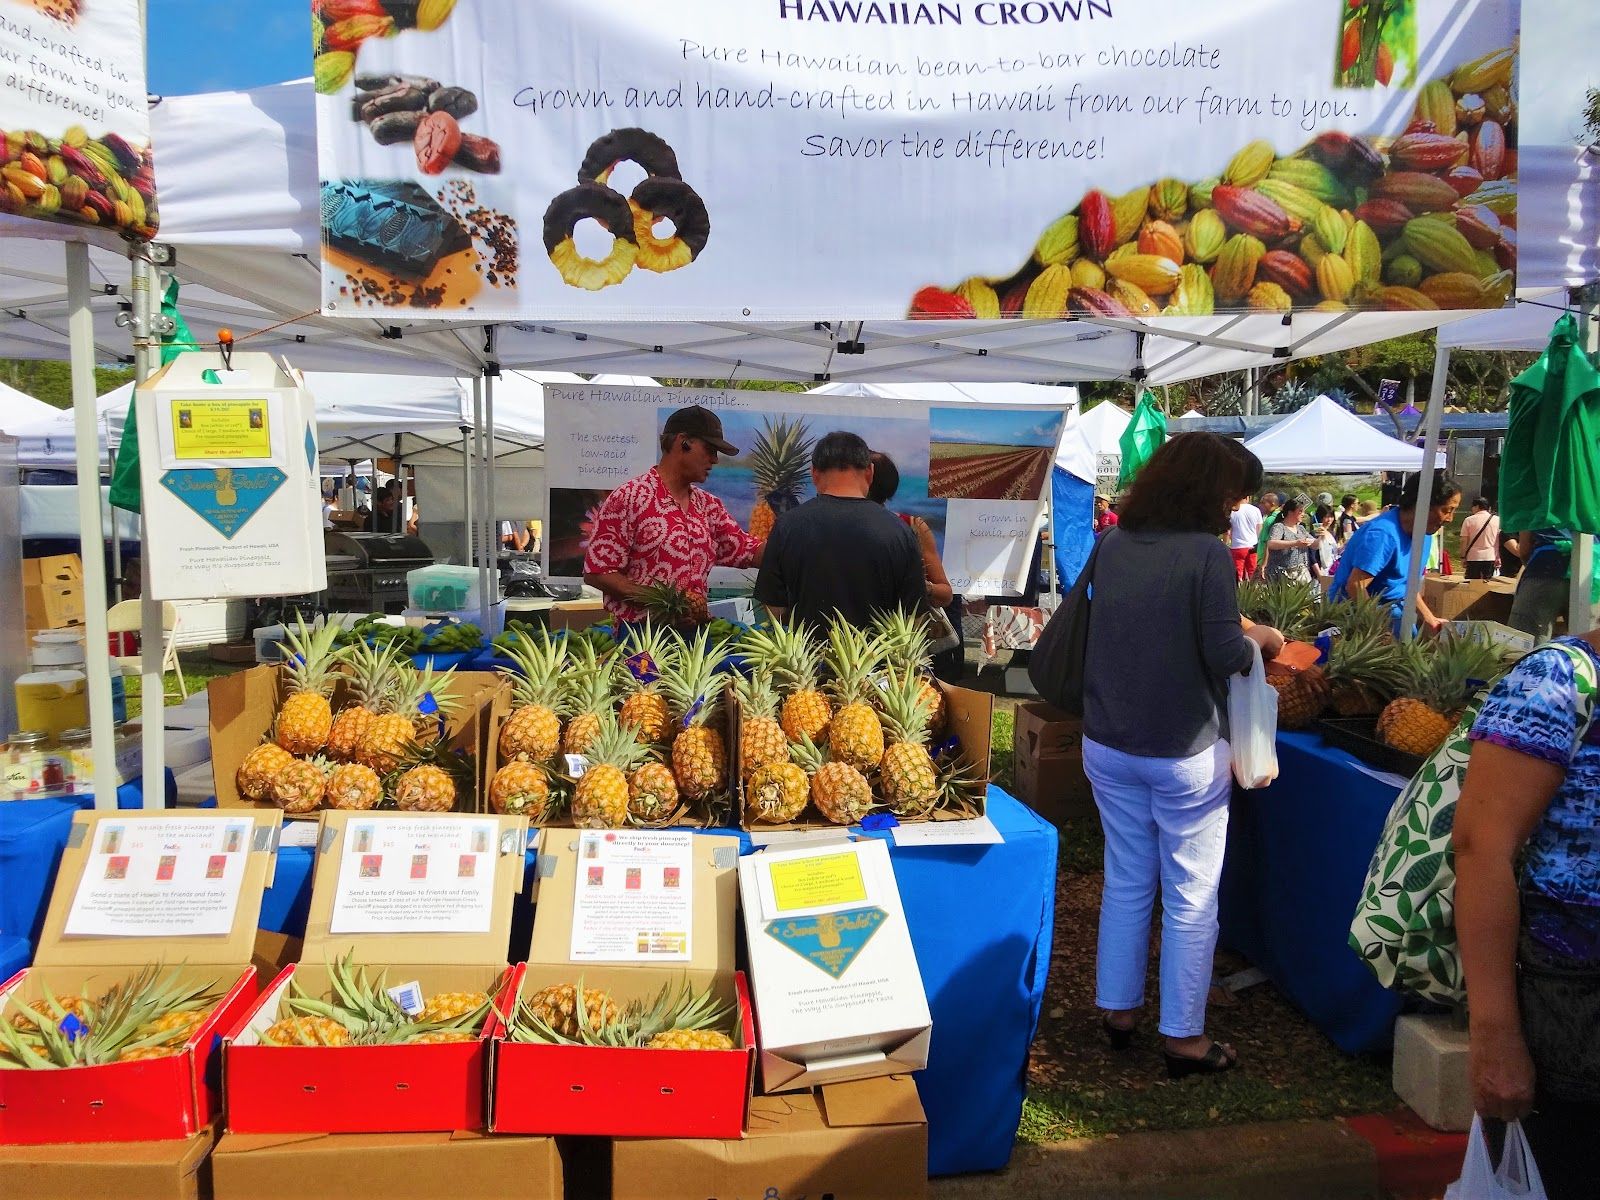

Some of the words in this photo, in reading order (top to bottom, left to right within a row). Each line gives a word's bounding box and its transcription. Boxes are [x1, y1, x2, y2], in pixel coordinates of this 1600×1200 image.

[779, 0, 962, 25] HAWAIIAN
[974, 0, 1113, 26] CROWN
[680, 38, 748, 64] Pure
[761, 49, 908, 76] Hawaiian
[917, 49, 1087, 77] bean-to-bar
[1098, 42, 1221, 70] chocolate
[29, 55, 77, 85] farm
[84, 77, 99, 94] to
[107, 88, 139, 112] you.
[111, 63, 128, 82] in
[6, 73, 104, 122] difference!
[513, 86, 613, 115] Grown
[625, 81, 682, 109] and
[697, 81, 894, 118] hand-crafted
[906, 90, 940, 110] in
[952, 84, 1056, 113] Hawaii
[1065, 84, 1133, 122] from
[1143, 97, 1189, 114] our
[1196, 86, 1262, 124] farm
[1271, 92, 1292, 118] to
[1303, 98, 1358, 130] you.
[801, 133, 892, 158] Savor
[901, 131, 944, 158] the
[955, 131, 1105, 167] difference!
[551, 388, 584, 401] Pure
[590, 389, 663, 403] Hawaiian
[668, 391, 749, 408] Pineapple...
[570, 432, 589, 443] The
[592, 432, 639, 445] sweetest,
[581, 448, 626, 459] low-acid
[578, 465, 629, 477] pineapple
[978, 513, 1011, 524] Grown
[1015, 513, 1027, 522] in
